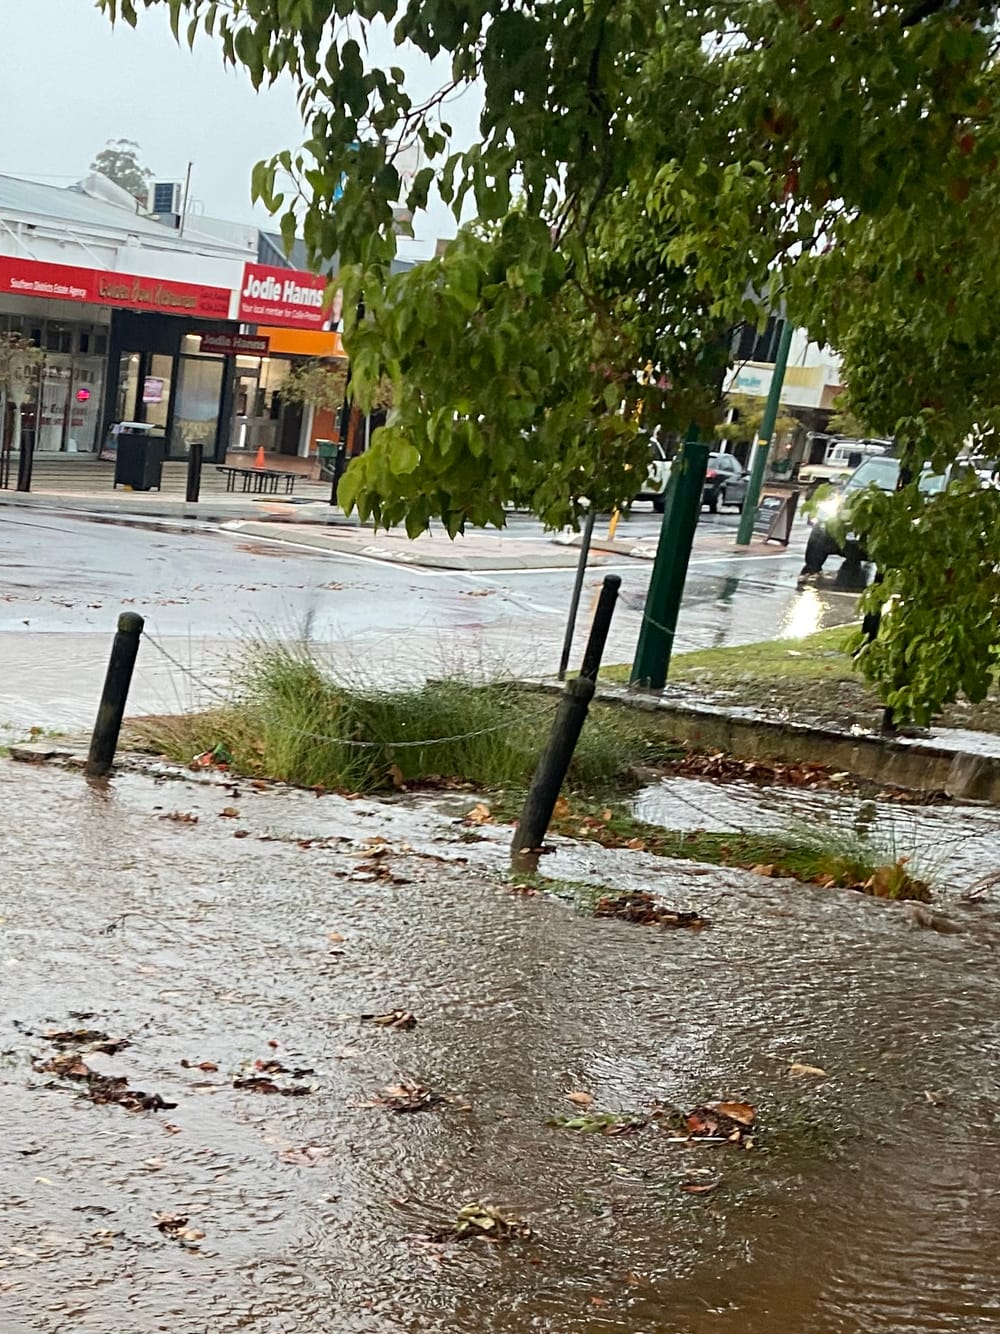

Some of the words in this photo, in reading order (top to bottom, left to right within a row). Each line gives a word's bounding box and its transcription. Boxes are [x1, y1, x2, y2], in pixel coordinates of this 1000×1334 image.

[242, 274, 282, 302] Jodie
[281, 279, 325, 308] Hanns
[203, 334, 234, 348] Jodie
[232, 337, 267, 351] Hanns
